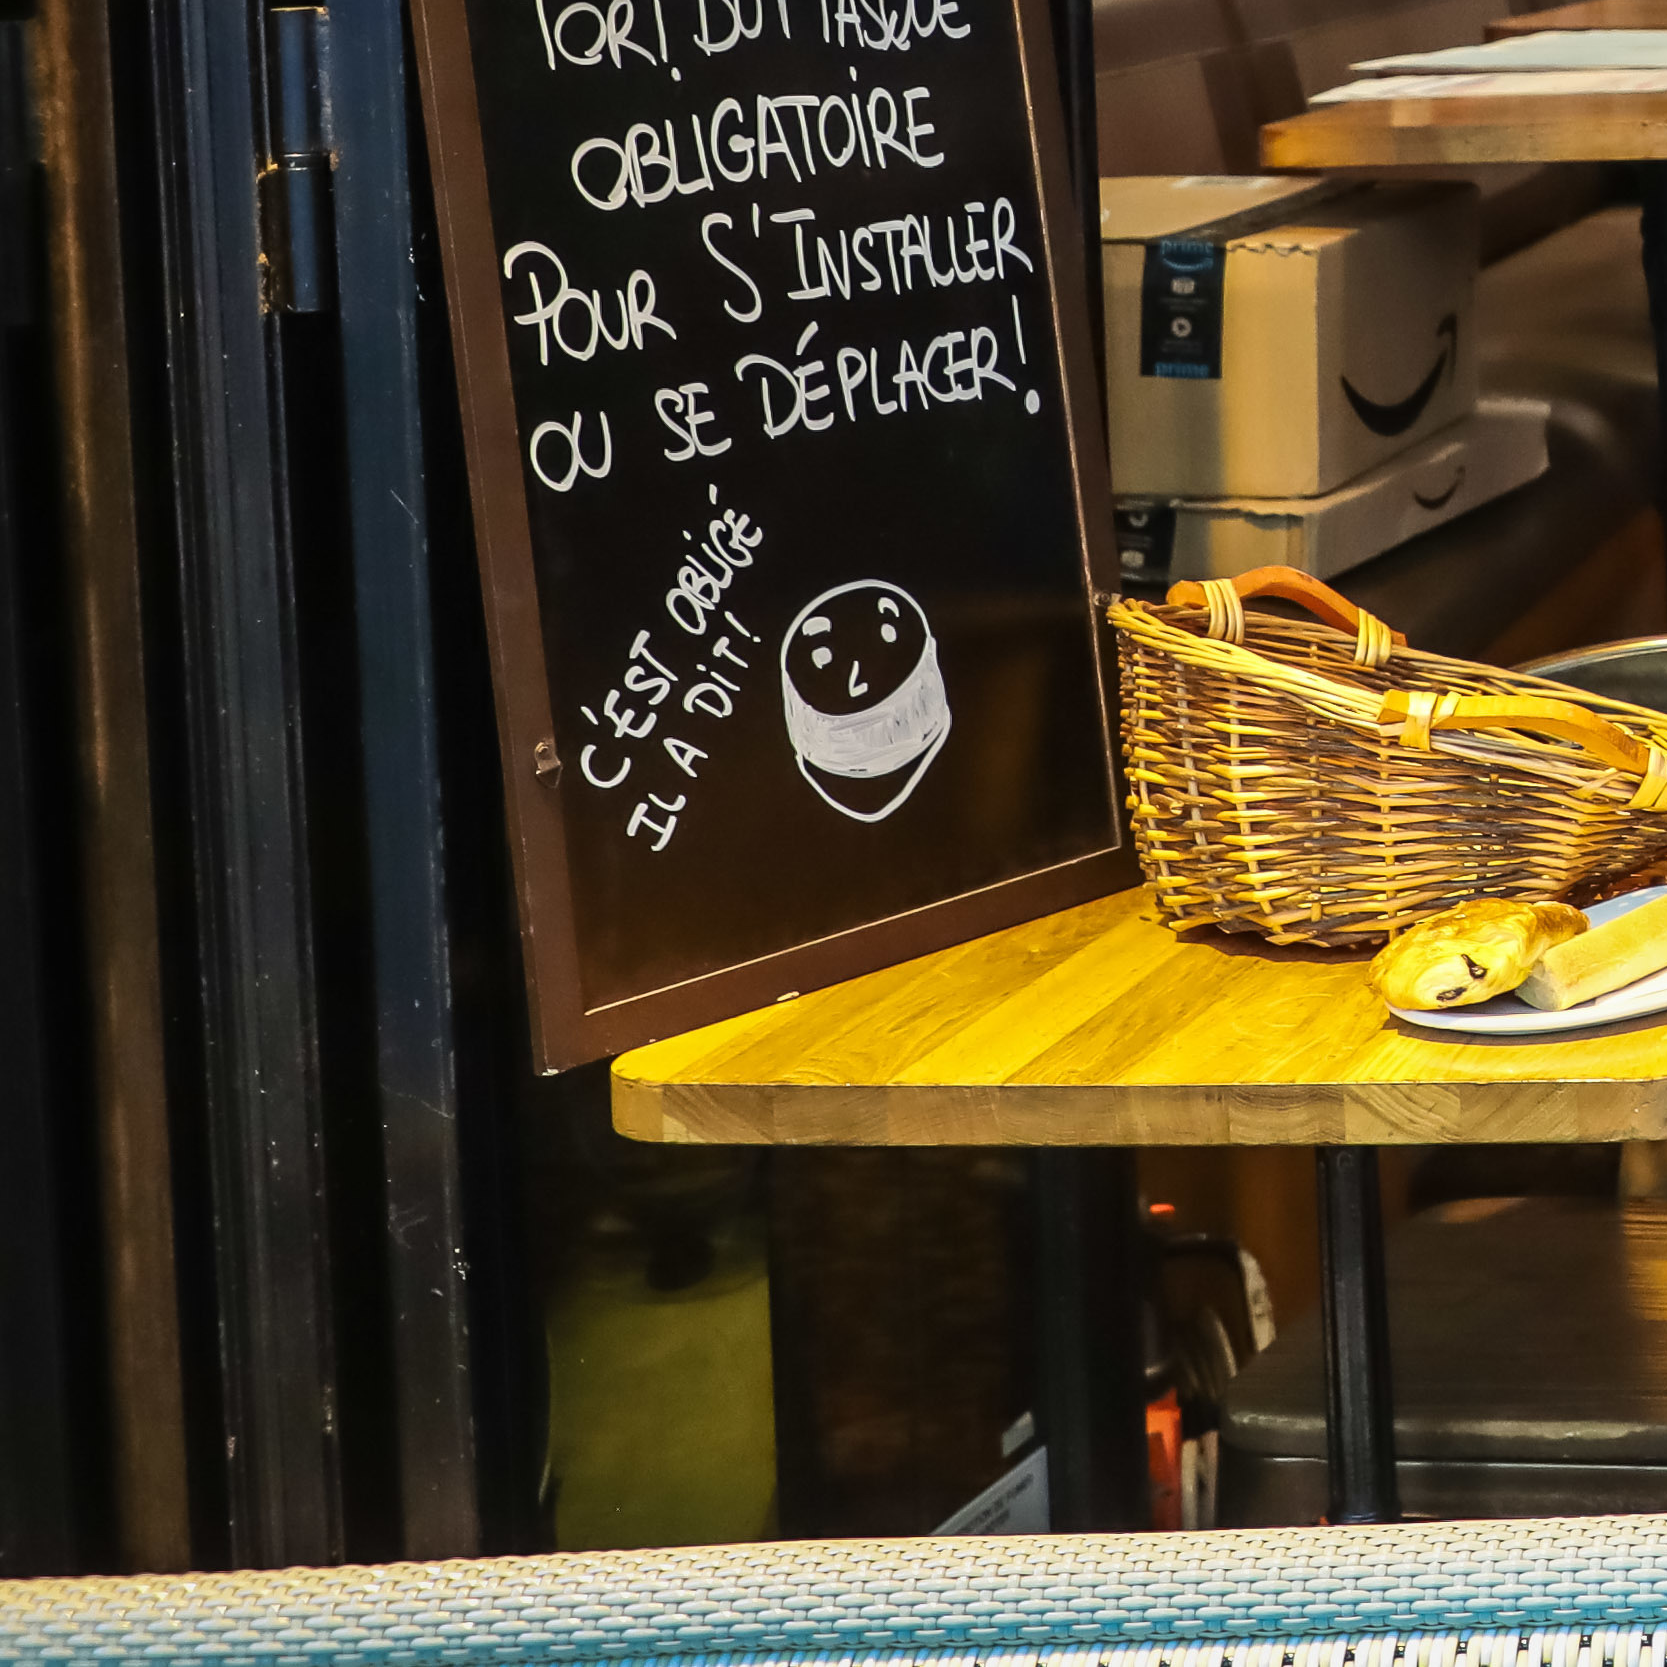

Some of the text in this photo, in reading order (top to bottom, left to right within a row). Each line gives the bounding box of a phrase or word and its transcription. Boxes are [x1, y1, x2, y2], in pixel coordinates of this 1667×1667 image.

[570, 65, 945, 211] OBLIGATOIRE
[503, 196, 1034, 366] POUR S'INSTALLER
[529, 410, 612, 493] OU
[654, 382, 732, 462] SE
[580, 629, 679, 789] C'EST
[626, 792, 687, 852] IL
[662, 736, 709, 778] A
